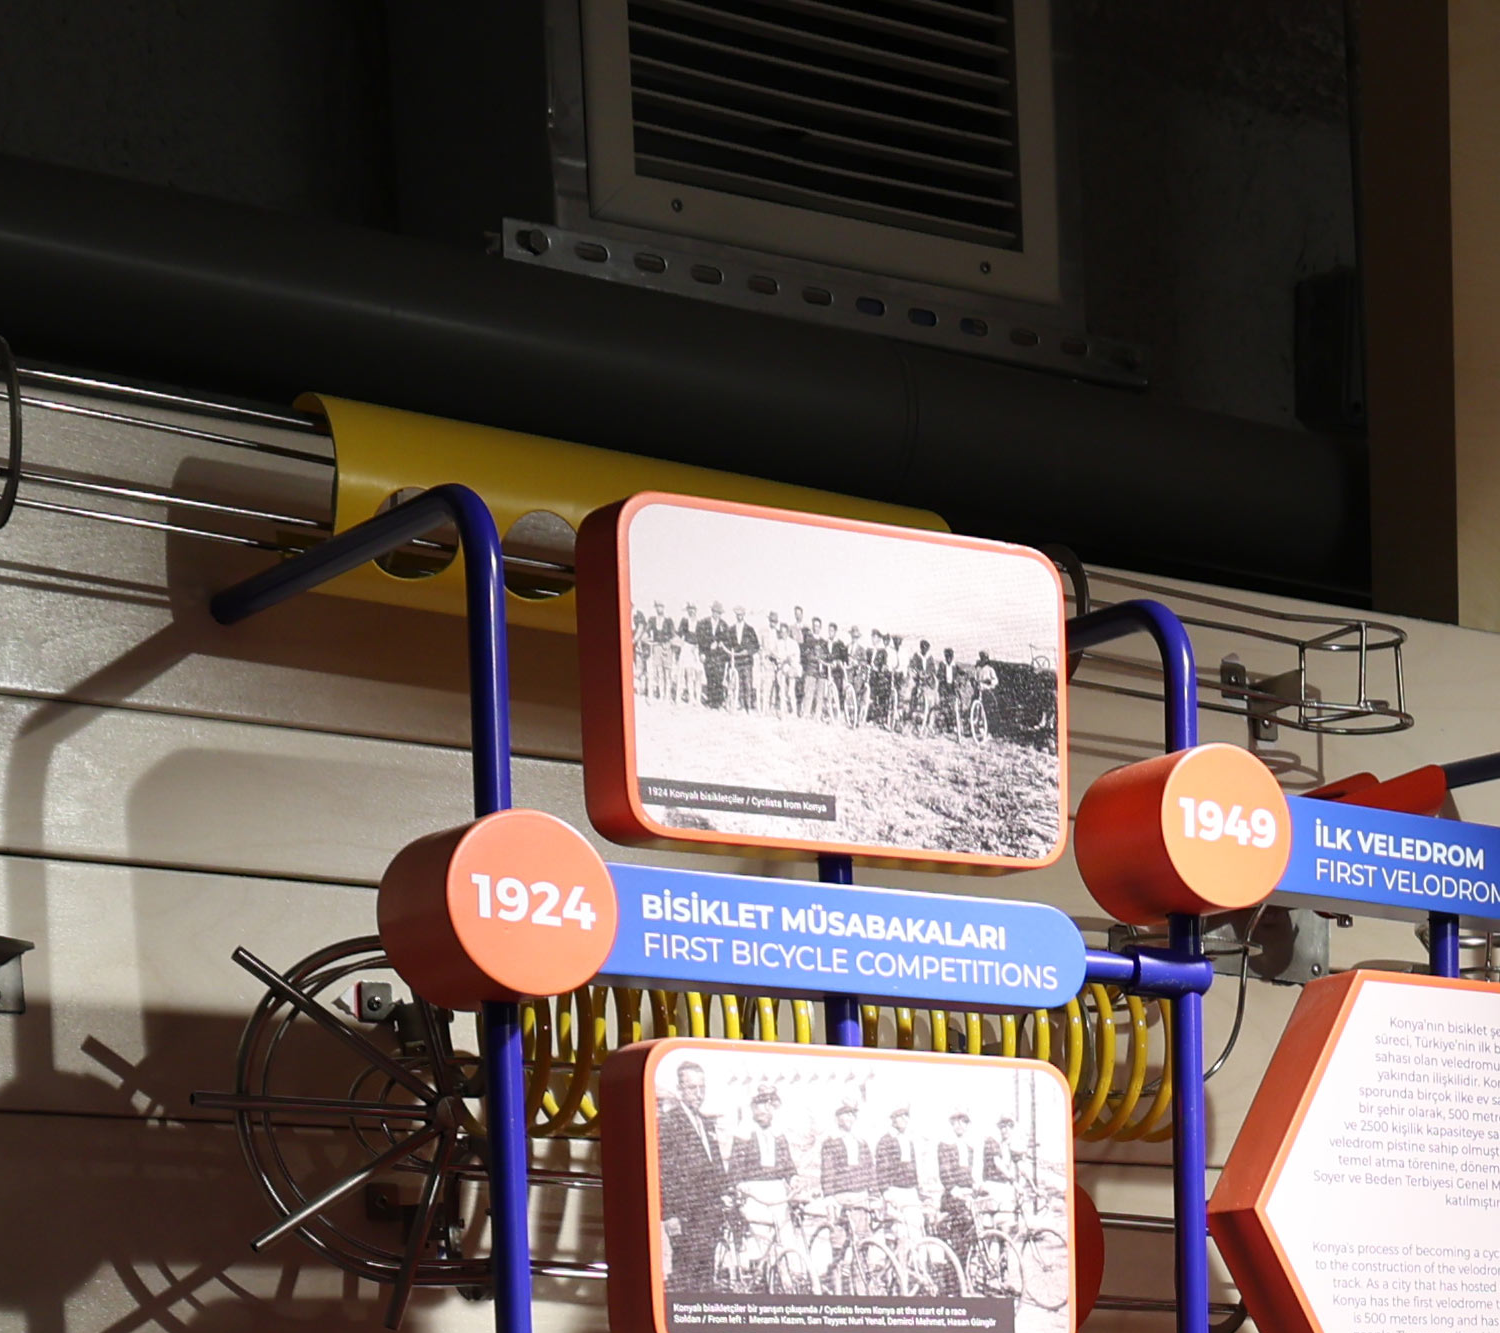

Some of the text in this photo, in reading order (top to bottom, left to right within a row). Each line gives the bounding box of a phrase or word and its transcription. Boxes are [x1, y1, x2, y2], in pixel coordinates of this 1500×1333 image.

[647, 785, 668, 797] 1924
[668, 787, 699, 801] Konyalı
[698, 790, 745, 805] bisikletçiler
[750, 795, 783, 809] Cyclists
[782, 797, 802, 810] from
[801, 800, 827, 814] Konya
[1179, 797, 1276, 848] 1949
[1315, 818, 1485, 870] İLK VELEDROM
[1316, 858, 1377, 888] FIRST
[470, 873, 596, 930] 1924
[641, 889, 1005, 950] BİSİKLET MÜSABAKALARI
[644, 932, 1058, 991] FIRST BICYCLE COMPETITIONS
[1389, 1016, 1445, 1033] Konya'nın
[1446, 1020, 1488, 1037] bisiklet
